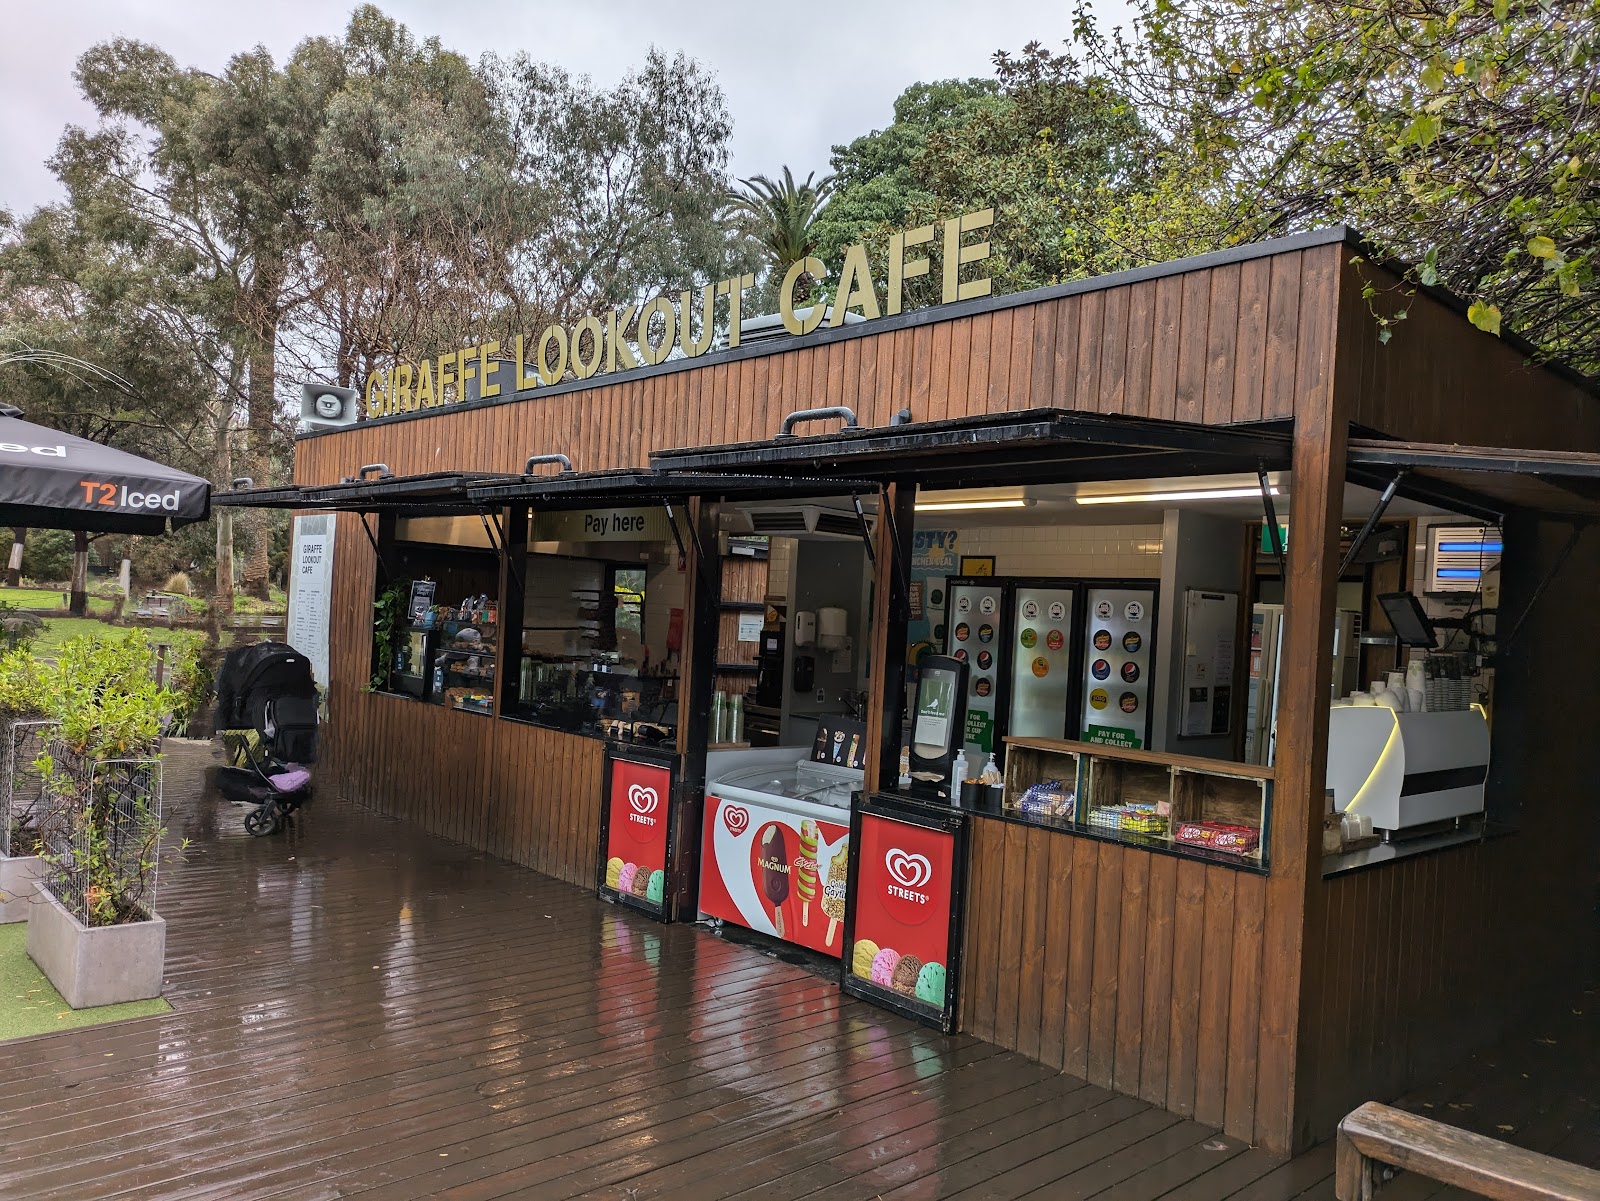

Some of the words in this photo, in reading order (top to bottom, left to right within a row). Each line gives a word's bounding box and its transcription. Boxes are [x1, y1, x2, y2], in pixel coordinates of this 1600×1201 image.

[366, 341, 500, 419] GIRAFFE
[515, 273, 755, 391] LOOKOUT
[780, 208, 994, 336] CAFE
[0, 443, 67, 458] ed
[80, 481, 118, 506] T2
[120, 486, 181, 511] Iced
[584, 514, 609, 536] Pay
[612, 513, 645, 531] here
[913, 531, 958, 549] STY?
[302, 544, 322, 554] GIRAFFE
[302, 555, 322, 564] LOOKOUT
[912, 556, 935, 566] NCHER
[301, 566, 313, 574] CAFE
[967, 720, 987, 729] OLLECT
[1097, 730, 1110, 738] PAY
[1112, 732, 1125, 740] FOR
[1090, 736, 1104, 744] AND
[1104, 739, 1133, 748] COLLECT
[629, 813, 654, 826] STREETS
[757, 857, 792, 875] MAGNUM
[887, 884, 926, 905] STREETS
